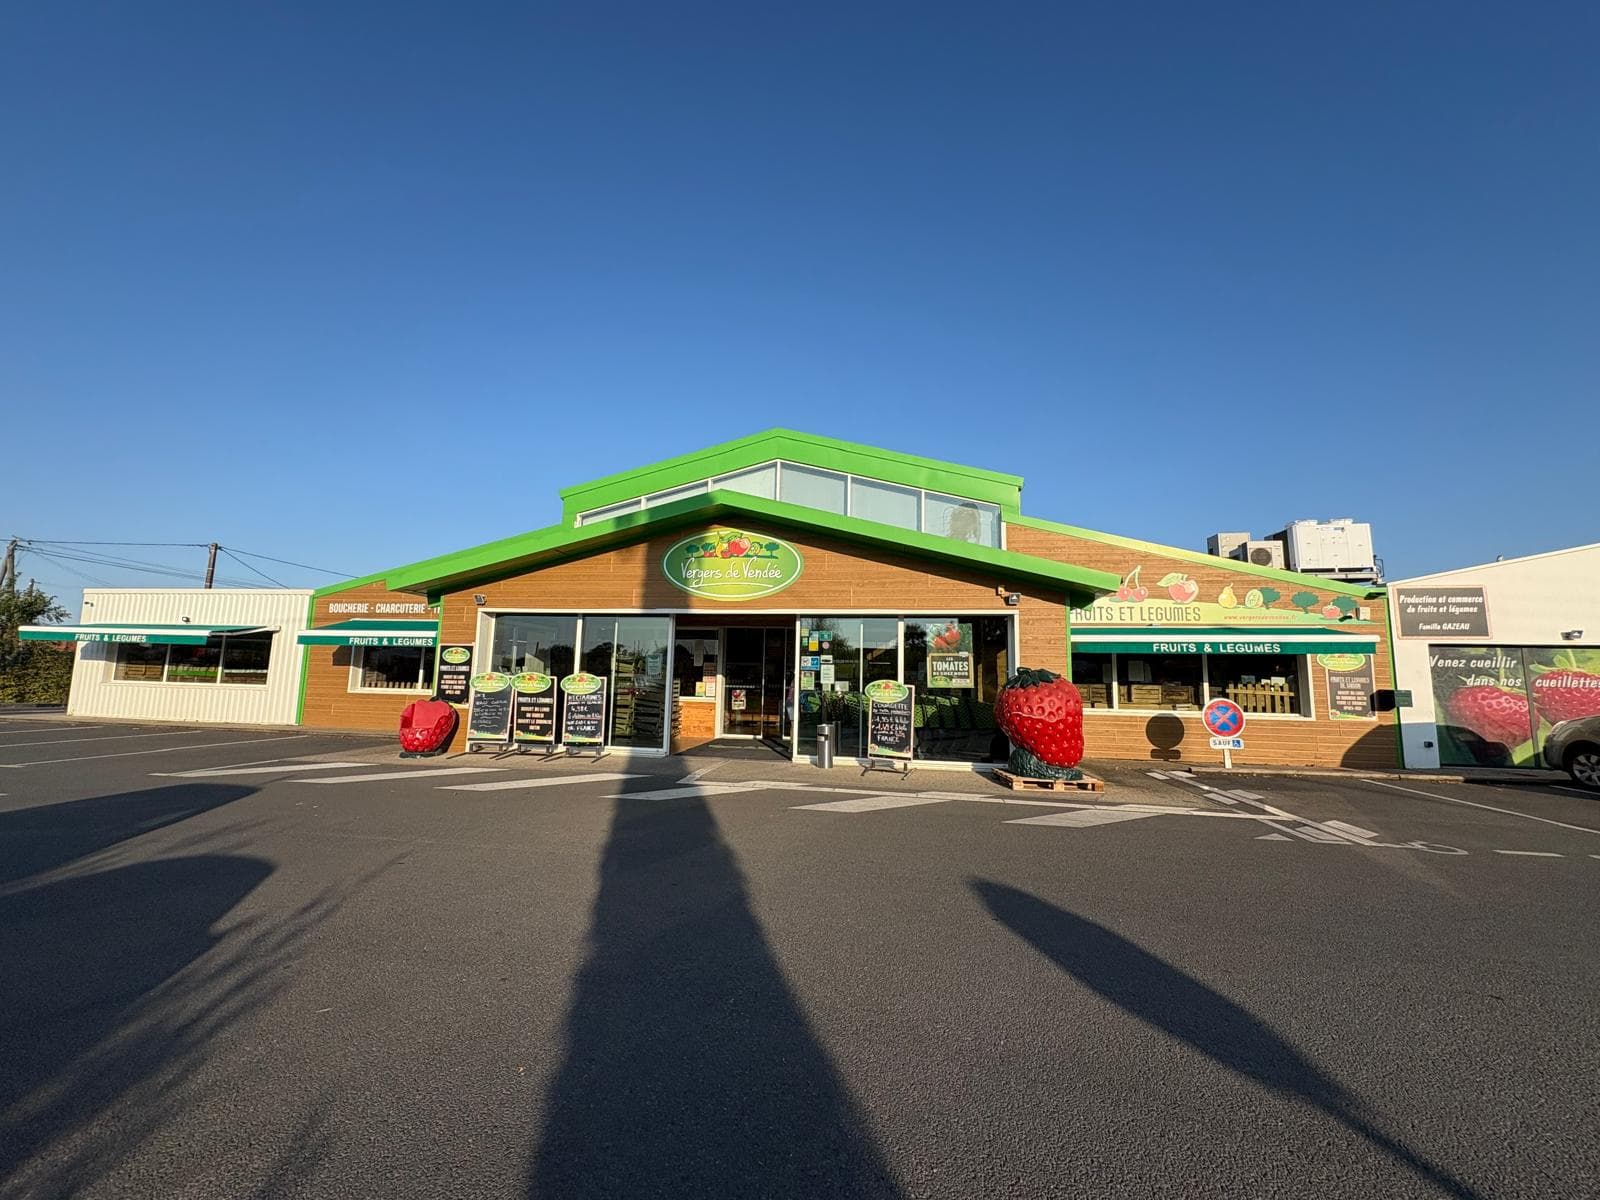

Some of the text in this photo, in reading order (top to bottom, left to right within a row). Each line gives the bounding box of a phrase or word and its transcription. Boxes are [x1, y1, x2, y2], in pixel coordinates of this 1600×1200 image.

[681, 556, 782, 586] Vergers de Vendée
[1400, 595, 1437, 604] Production
[328, 603, 369, 613] BOUCHERIE
[375, 603, 425, 614] CHARCUTERIE
[1119, 606, 1134, 621] ET
[1140, 606, 1201, 621] LEGUMES
[1406, 605, 1416, 613] de
[1417, 605, 1438, 613] fruits
[1448, 604, 1478, 615] légumes
[1419, 622, 1470, 630] Famille GAZEAU
[74, 633, 100, 641] FRUITS
[111, 634, 147, 643] LEGUMES
[349, 637, 378, 645] FRUITS
[392, 638, 433, 646] LEGUMES
[1152, 643, 1281, 653] FRUITS & LEGUMES
[932, 661, 969, 671] TOMATES
[1430, 655, 1517, 668] Venez cueillir
[1466, 673, 1495, 686] dans
[1500, 678, 1521, 687] nos
